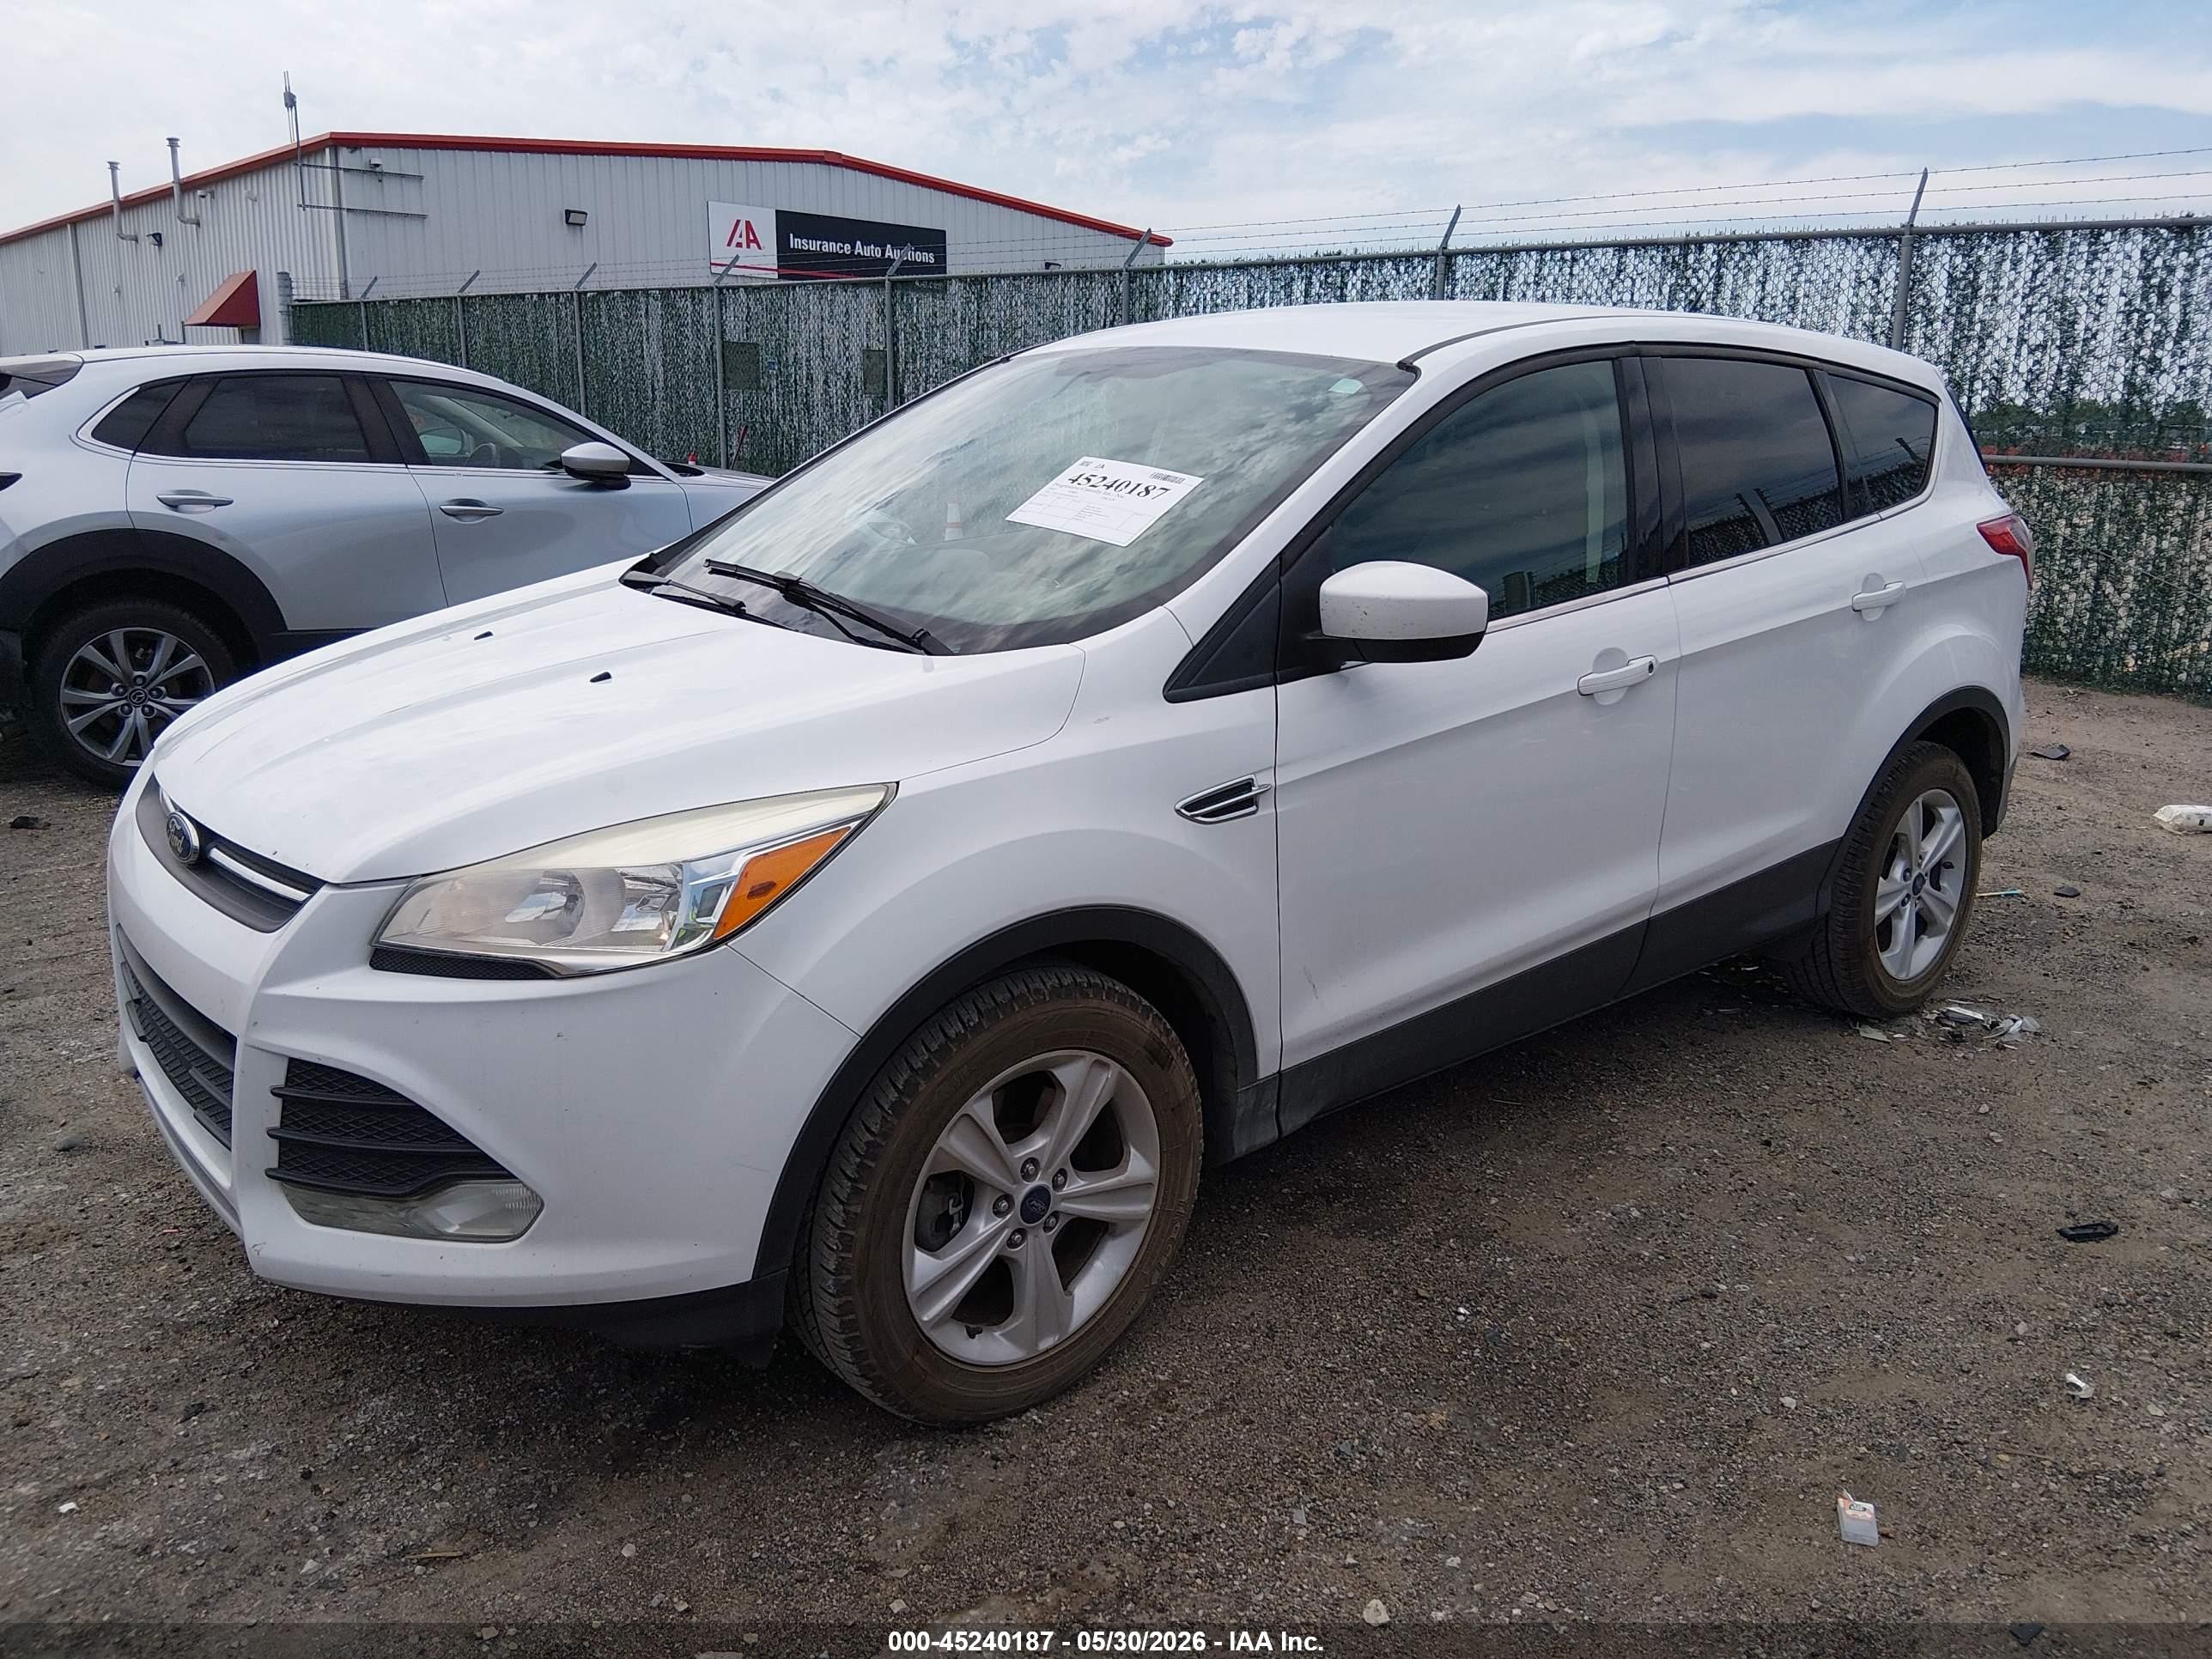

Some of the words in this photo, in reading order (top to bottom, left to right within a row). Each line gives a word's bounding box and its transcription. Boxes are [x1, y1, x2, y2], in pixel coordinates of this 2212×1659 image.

[789, 233, 851, 255] Insurance
[854, 240, 882, 258] Auto
[884, 244, 935, 264] Auctions
[1067, 472, 1171, 500] 45240187
[167, 818, 185, 854] Ford
